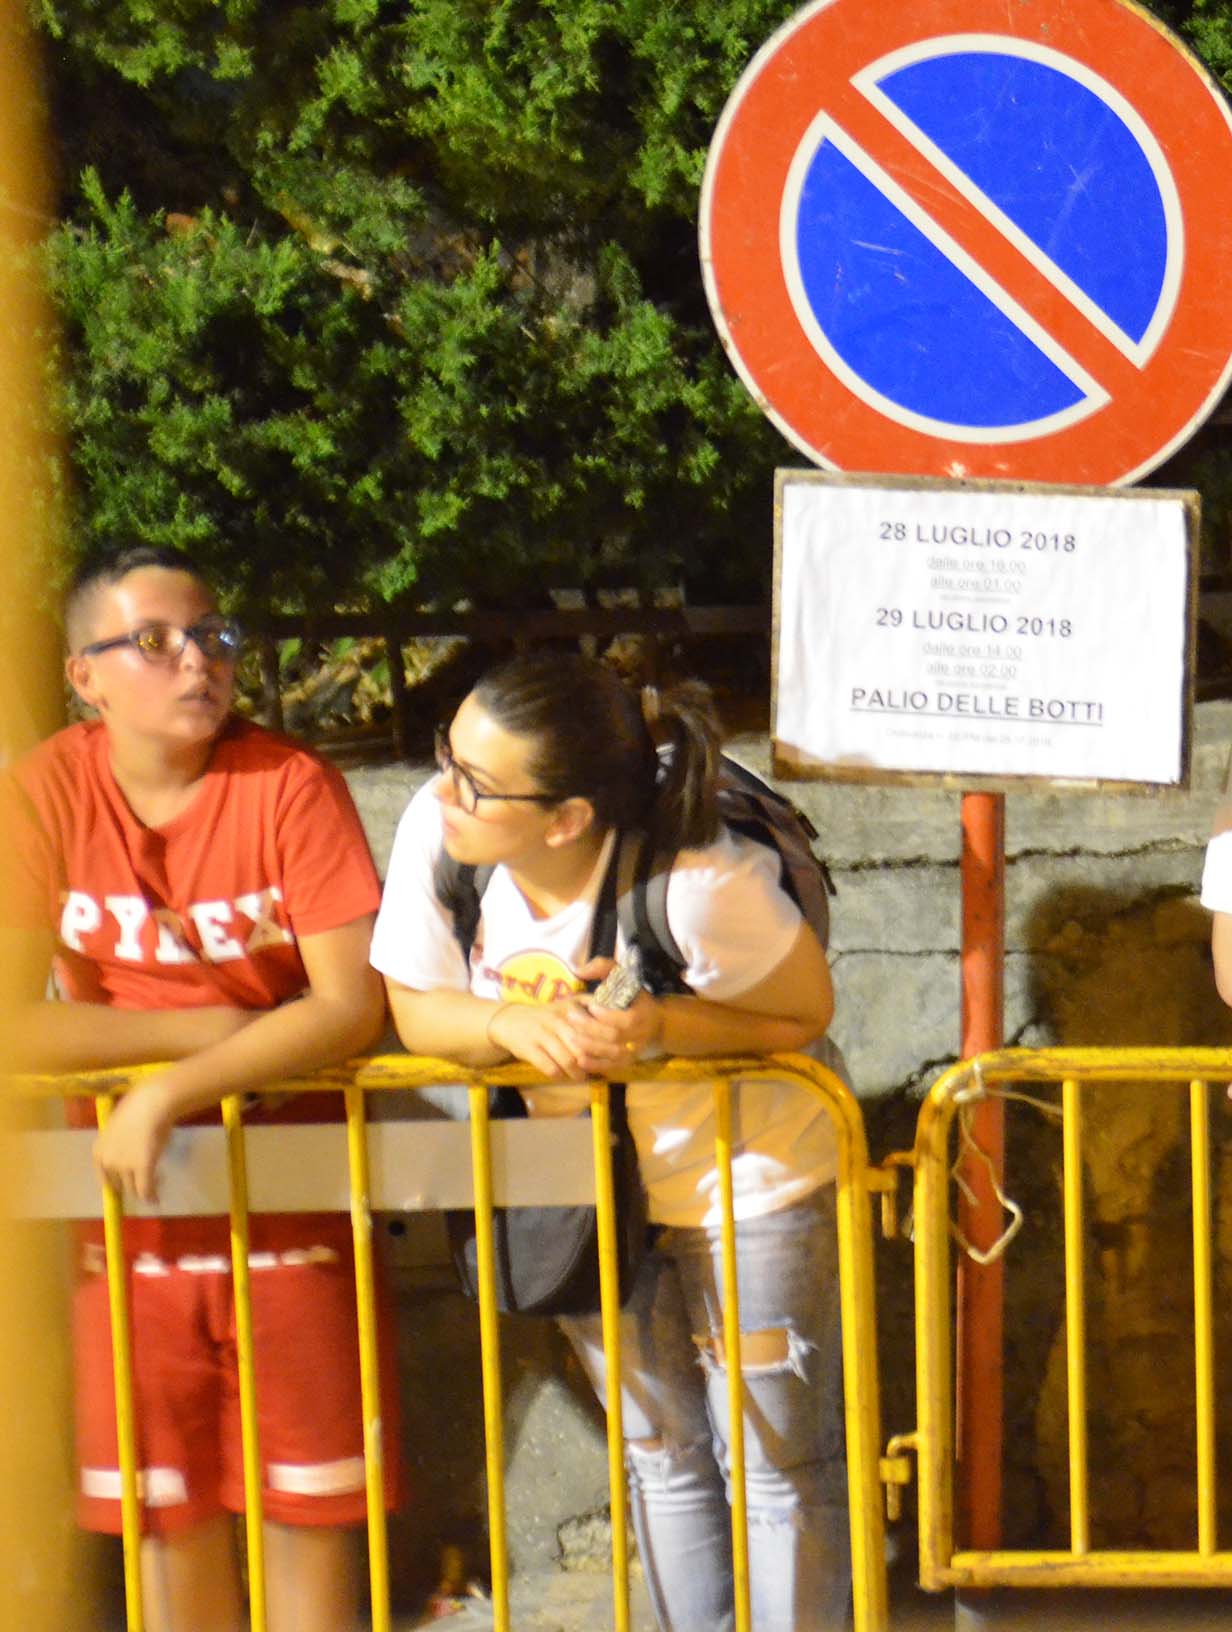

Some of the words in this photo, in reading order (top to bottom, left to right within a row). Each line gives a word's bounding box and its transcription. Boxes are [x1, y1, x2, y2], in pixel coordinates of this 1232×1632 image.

[879, 521, 907, 541] 28
[916, 523, 1012, 549] LUGLIO
[1020, 530, 1077, 553] 2018
[875, 607, 904, 627] 29
[912, 609, 1008, 634] LUGLIO
[1016, 616, 1073, 639] 2018
[850, 687, 929, 712] PALIO
[938, 692, 1020, 717] DELLE
[1029, 699, 1104, 722] BOTTI
